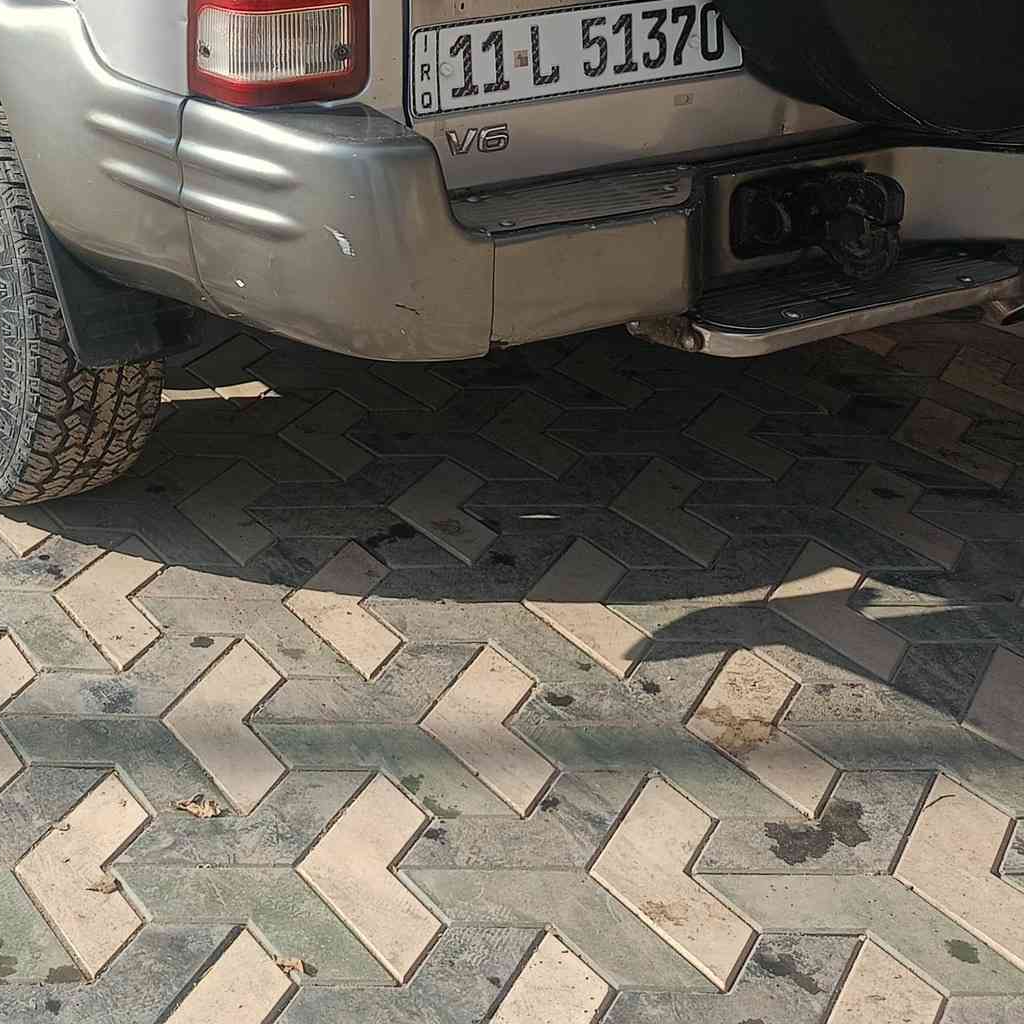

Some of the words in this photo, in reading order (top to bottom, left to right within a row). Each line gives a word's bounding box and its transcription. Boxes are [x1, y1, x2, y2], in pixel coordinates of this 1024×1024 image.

[449, 30, 510, 98] 11
[530, 25, 560, 86] L
[581, 2, 725, 78] 51370
[445, 123, 510, 157] V6
